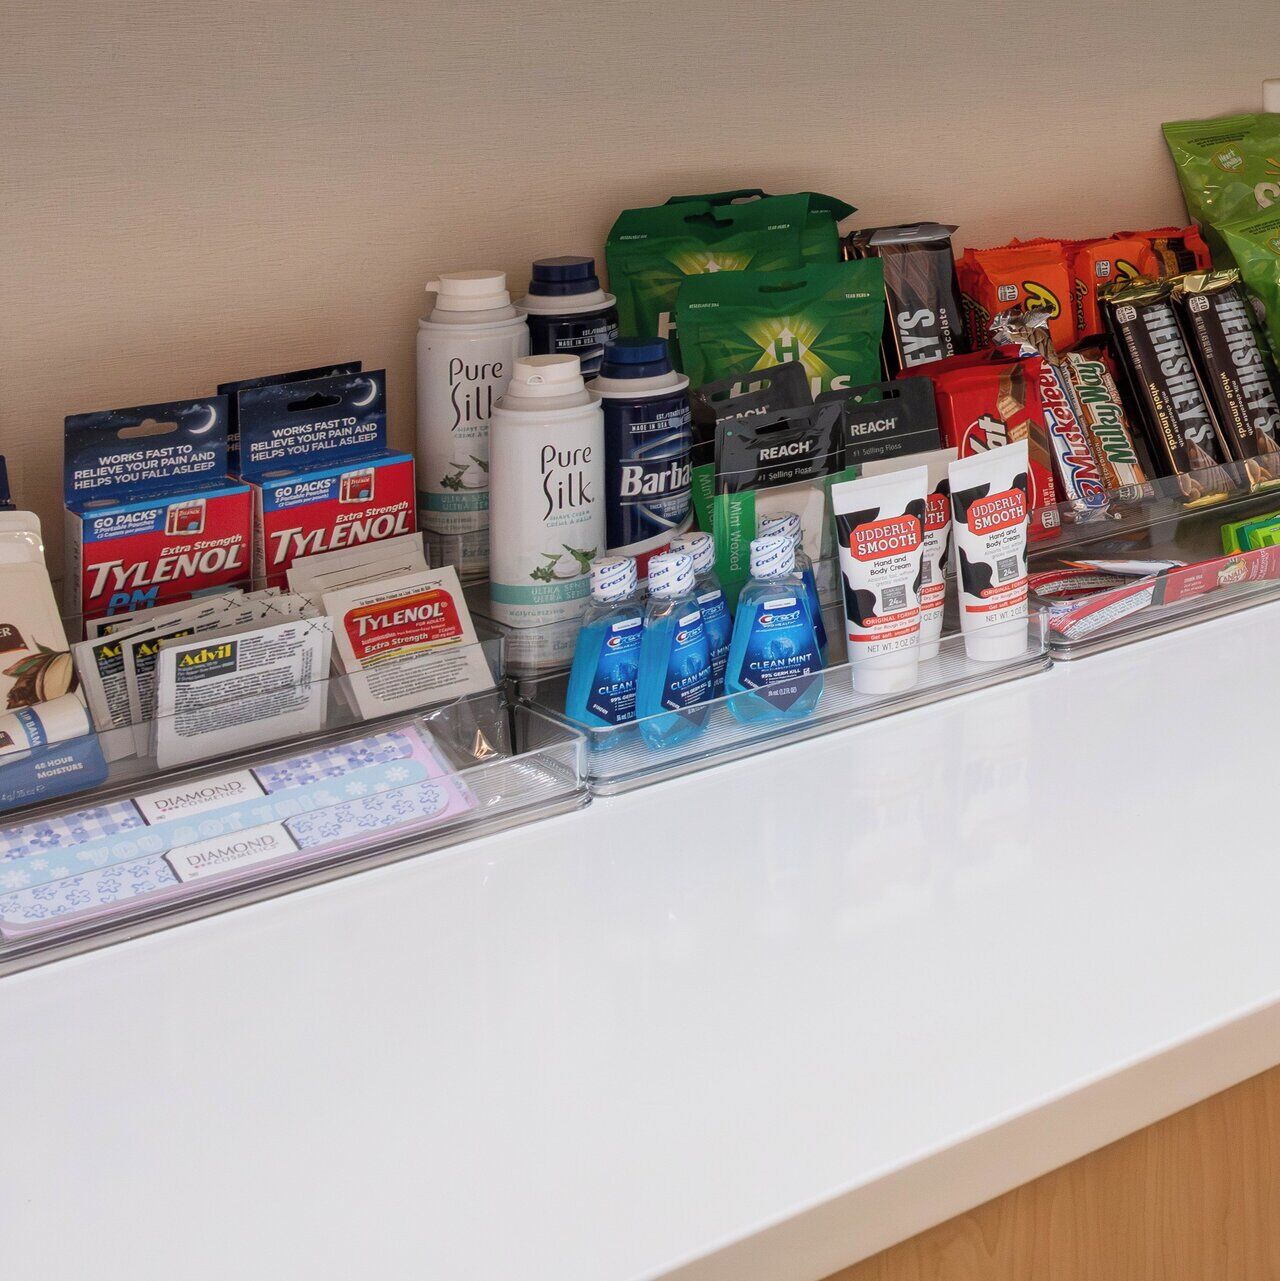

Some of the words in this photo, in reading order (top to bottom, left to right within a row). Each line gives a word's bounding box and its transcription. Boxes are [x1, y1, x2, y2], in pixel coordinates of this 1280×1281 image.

[1143, 307, 1215, 444] HERSHEY'S
[1075, 361, 1104, 404] Way
[1091, 404, 1137, 465] Milky
[1221, 372, 1233, 399] whole
[1230, 399, 1246, 439] almonds
[273, 425, 312, 438] WORKS
[315, 420, 340, 431] FAST
[851, 419, 895, 437] REACH
[1159, 412, 1177, 450] almonds
[251, 438, 294, 452] RELIEVE
[297, 433, 326, 445] YOUR
[252, 449, 284, 462] HELPS
[339, 433, 377, 446] ASLEEP
[760, 441, 810, 462] REACH
[74, 462, 123, 480] RELIEVE
[126, 460, 158, 474] YOUR
[161, 456, 187, 468] PAIN
[188, 452, 215, 463] AND
[99, 452, 143, 466] WORKS
[146, 447, 174, 459] FAST
[176, 445, 192, 455] TO
[541, 445, 592, 474] Pure
[74, 477, 112, 490] HELPS
[115, 473, 139, 484] YOU
[142, 470, 169, 481] FALL
[172, 462, 215, 476] ASLEEP
[768, 468, 792, 482] Selling
[794, 464, 812, 477] Floss
[295, 479, 331, 494] PACKS
[543, 470, 592, 521] Silk
[365, 501, 408, 518] Strength
[972, 493, 1022, 519] UDDERLY
[974, 506, 1024, 531] SMOOTH
[270, 511, 410, 565] TYLENOL
[855, 521, 916, 544] UDDERLY
[986, 541, 1002, 551] Body
[1002, 534, 1021, 546] Cream
[989, 533, 1005, 542] Hand
[160, 544, 191, 557] Extra
[858, 533, 917, 556] SMOOTH
[87, 544, 243, 599] TYLENOL
[759, 609, 801, 625] Crest
[865, 614, 896, 627] ORIGINAL
[179, 644, 232, 668] Advil
[867, 645, 881, 653] NET
[750, 658, 788, 671] CLEAN
[790, 653, 812, 666] MINT
[154, 781, 242, 810] DIAMOND
